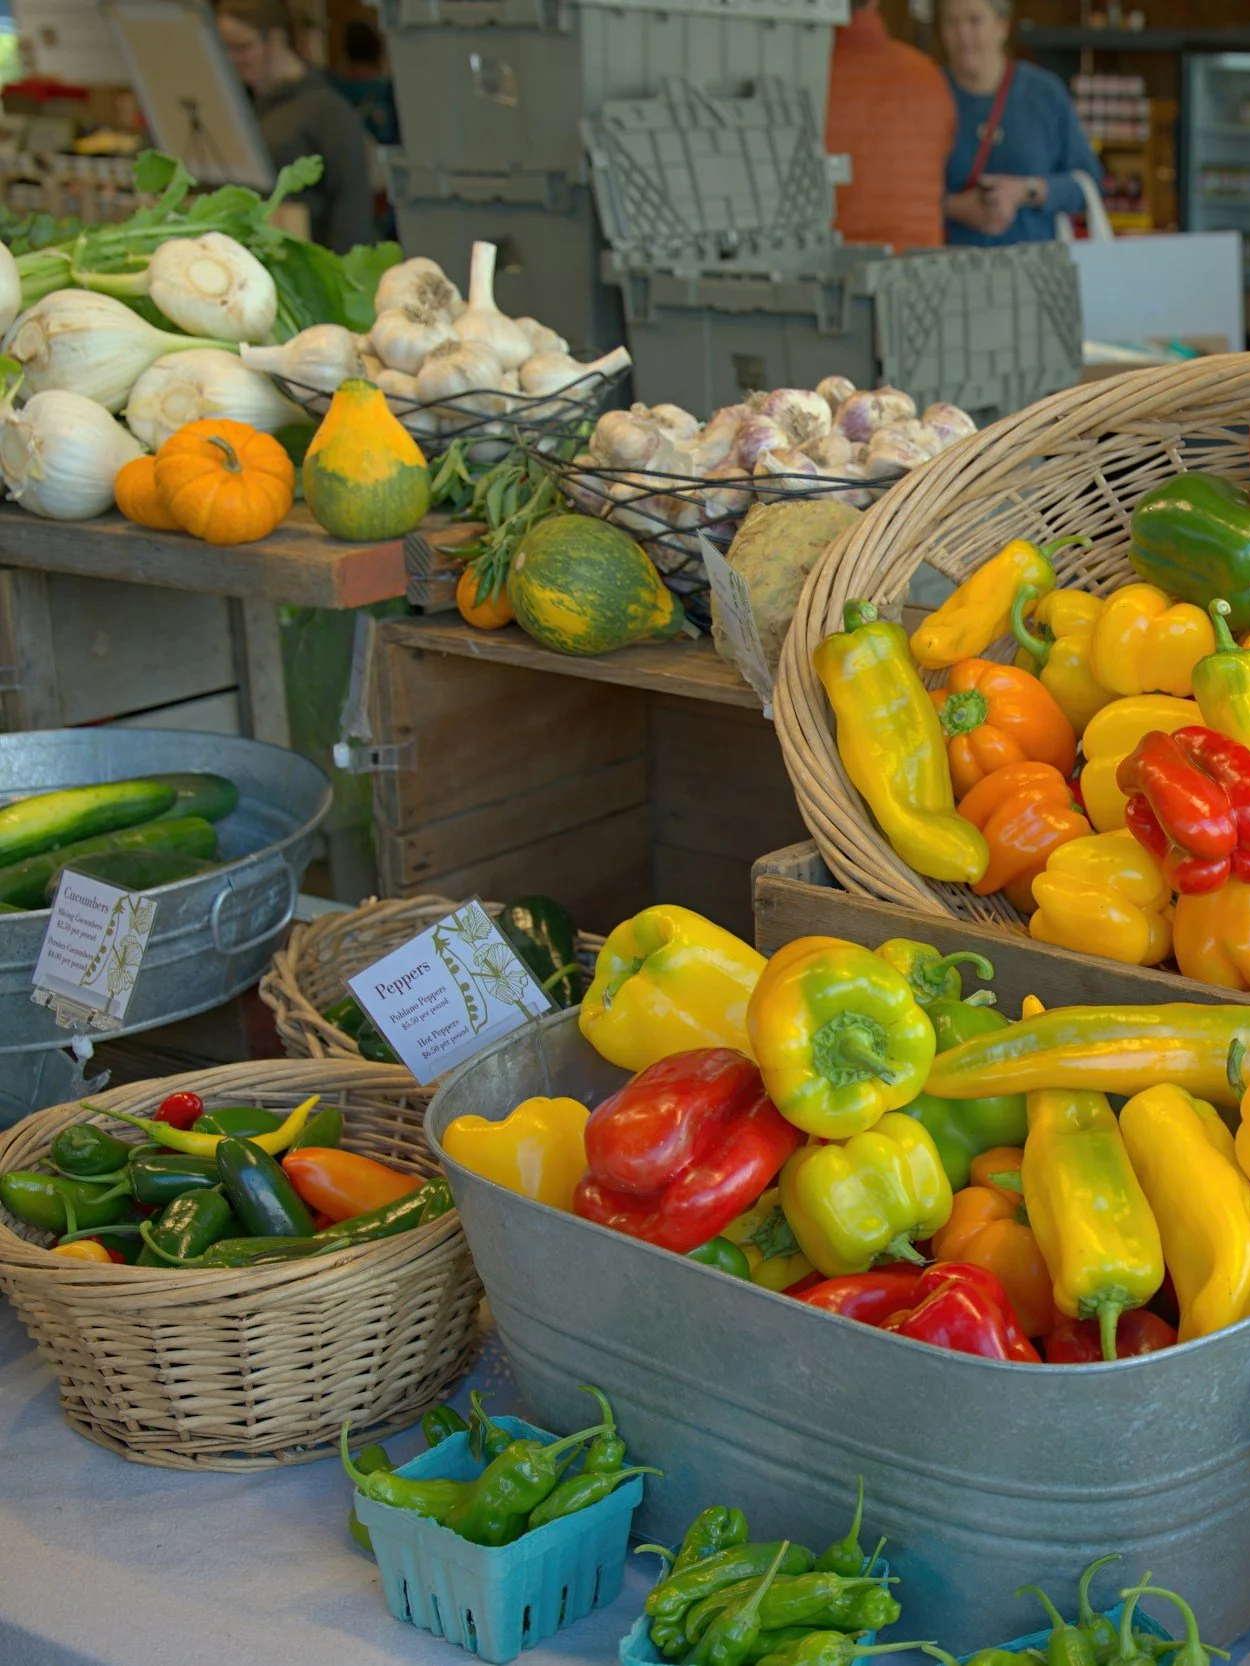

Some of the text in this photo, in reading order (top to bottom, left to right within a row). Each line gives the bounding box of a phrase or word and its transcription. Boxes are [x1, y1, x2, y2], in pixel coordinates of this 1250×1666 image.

[64, 886, 110, 914] Cucumbers
[70, 927, 80, 936] per
[79, 930, 97, 942] pound
[75, 913, 102, 931] Cucumbers
[61, 956, 71, 965] per
[70, 960, 88, 971] pound
[374, 961, 431, 1000] Peppers
[389, 986, 447, 1024] Poblano Peppers
[401, 997, 449, 1030] $5.50 per pound
[416, 1020, 460, 1048] Hot Peppers
[422, 1026, 470, 1059] $6.50 per pound
